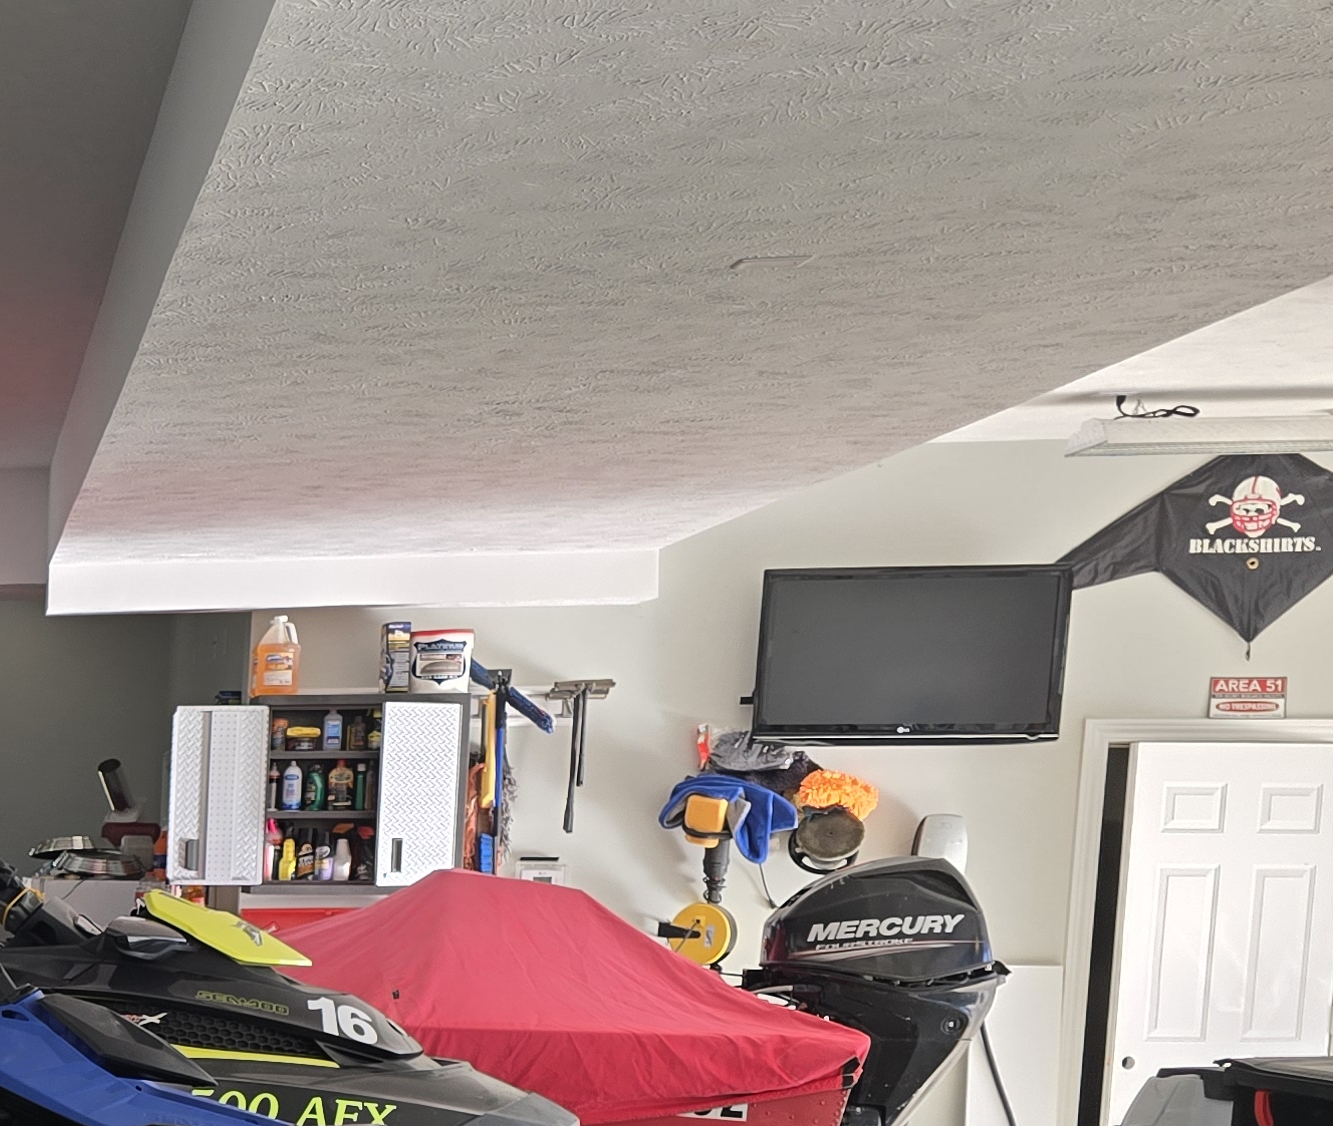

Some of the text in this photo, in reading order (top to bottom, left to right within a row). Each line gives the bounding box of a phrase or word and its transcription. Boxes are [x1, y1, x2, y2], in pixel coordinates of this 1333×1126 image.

[1189, 537, 1316, 553] BLACKSHIRTS
[1215, 679, 1282, 692] AREA 51
[807, 914, 965, 942] MERCURY
[307, 996, 378, 1045] 16
